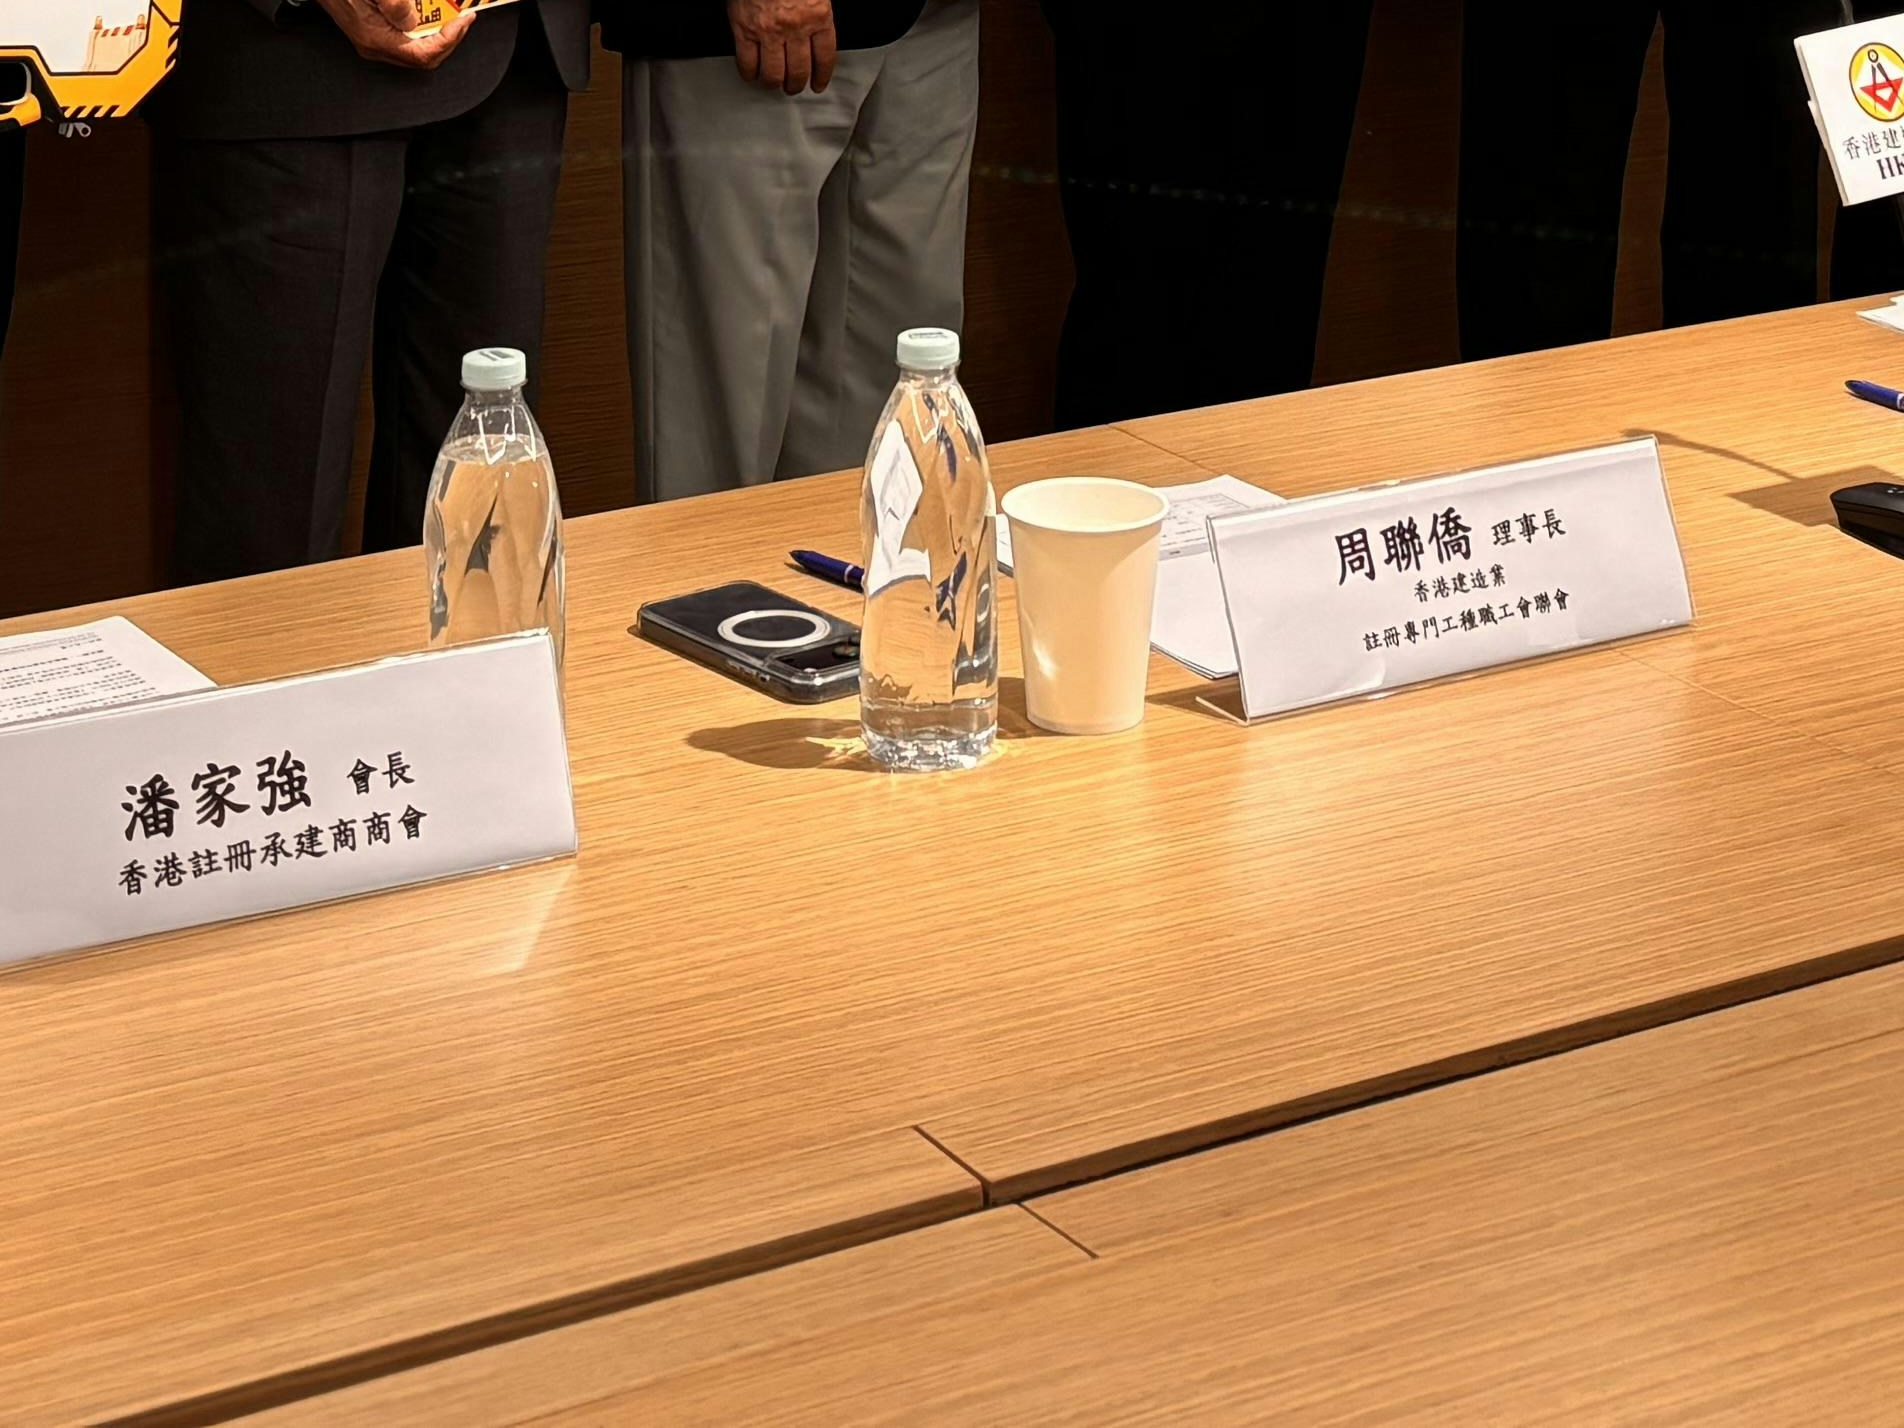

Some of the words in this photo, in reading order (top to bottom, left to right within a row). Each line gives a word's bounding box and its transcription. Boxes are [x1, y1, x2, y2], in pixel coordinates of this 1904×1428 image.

[1334, 506, 1473, 586] 周聯僑
[1491, 508, 1567, 548] 理事長
[1414, 563, 1507, 603] 香港建造業
[1362, 587, 1570, 651] 註冊專門工種職工會聯會
[120, 749, 313, 842] 潘家強
[345, 750, 417, 797] 會長
[117, 804, 429, 896] 香港註冊承建商商會
